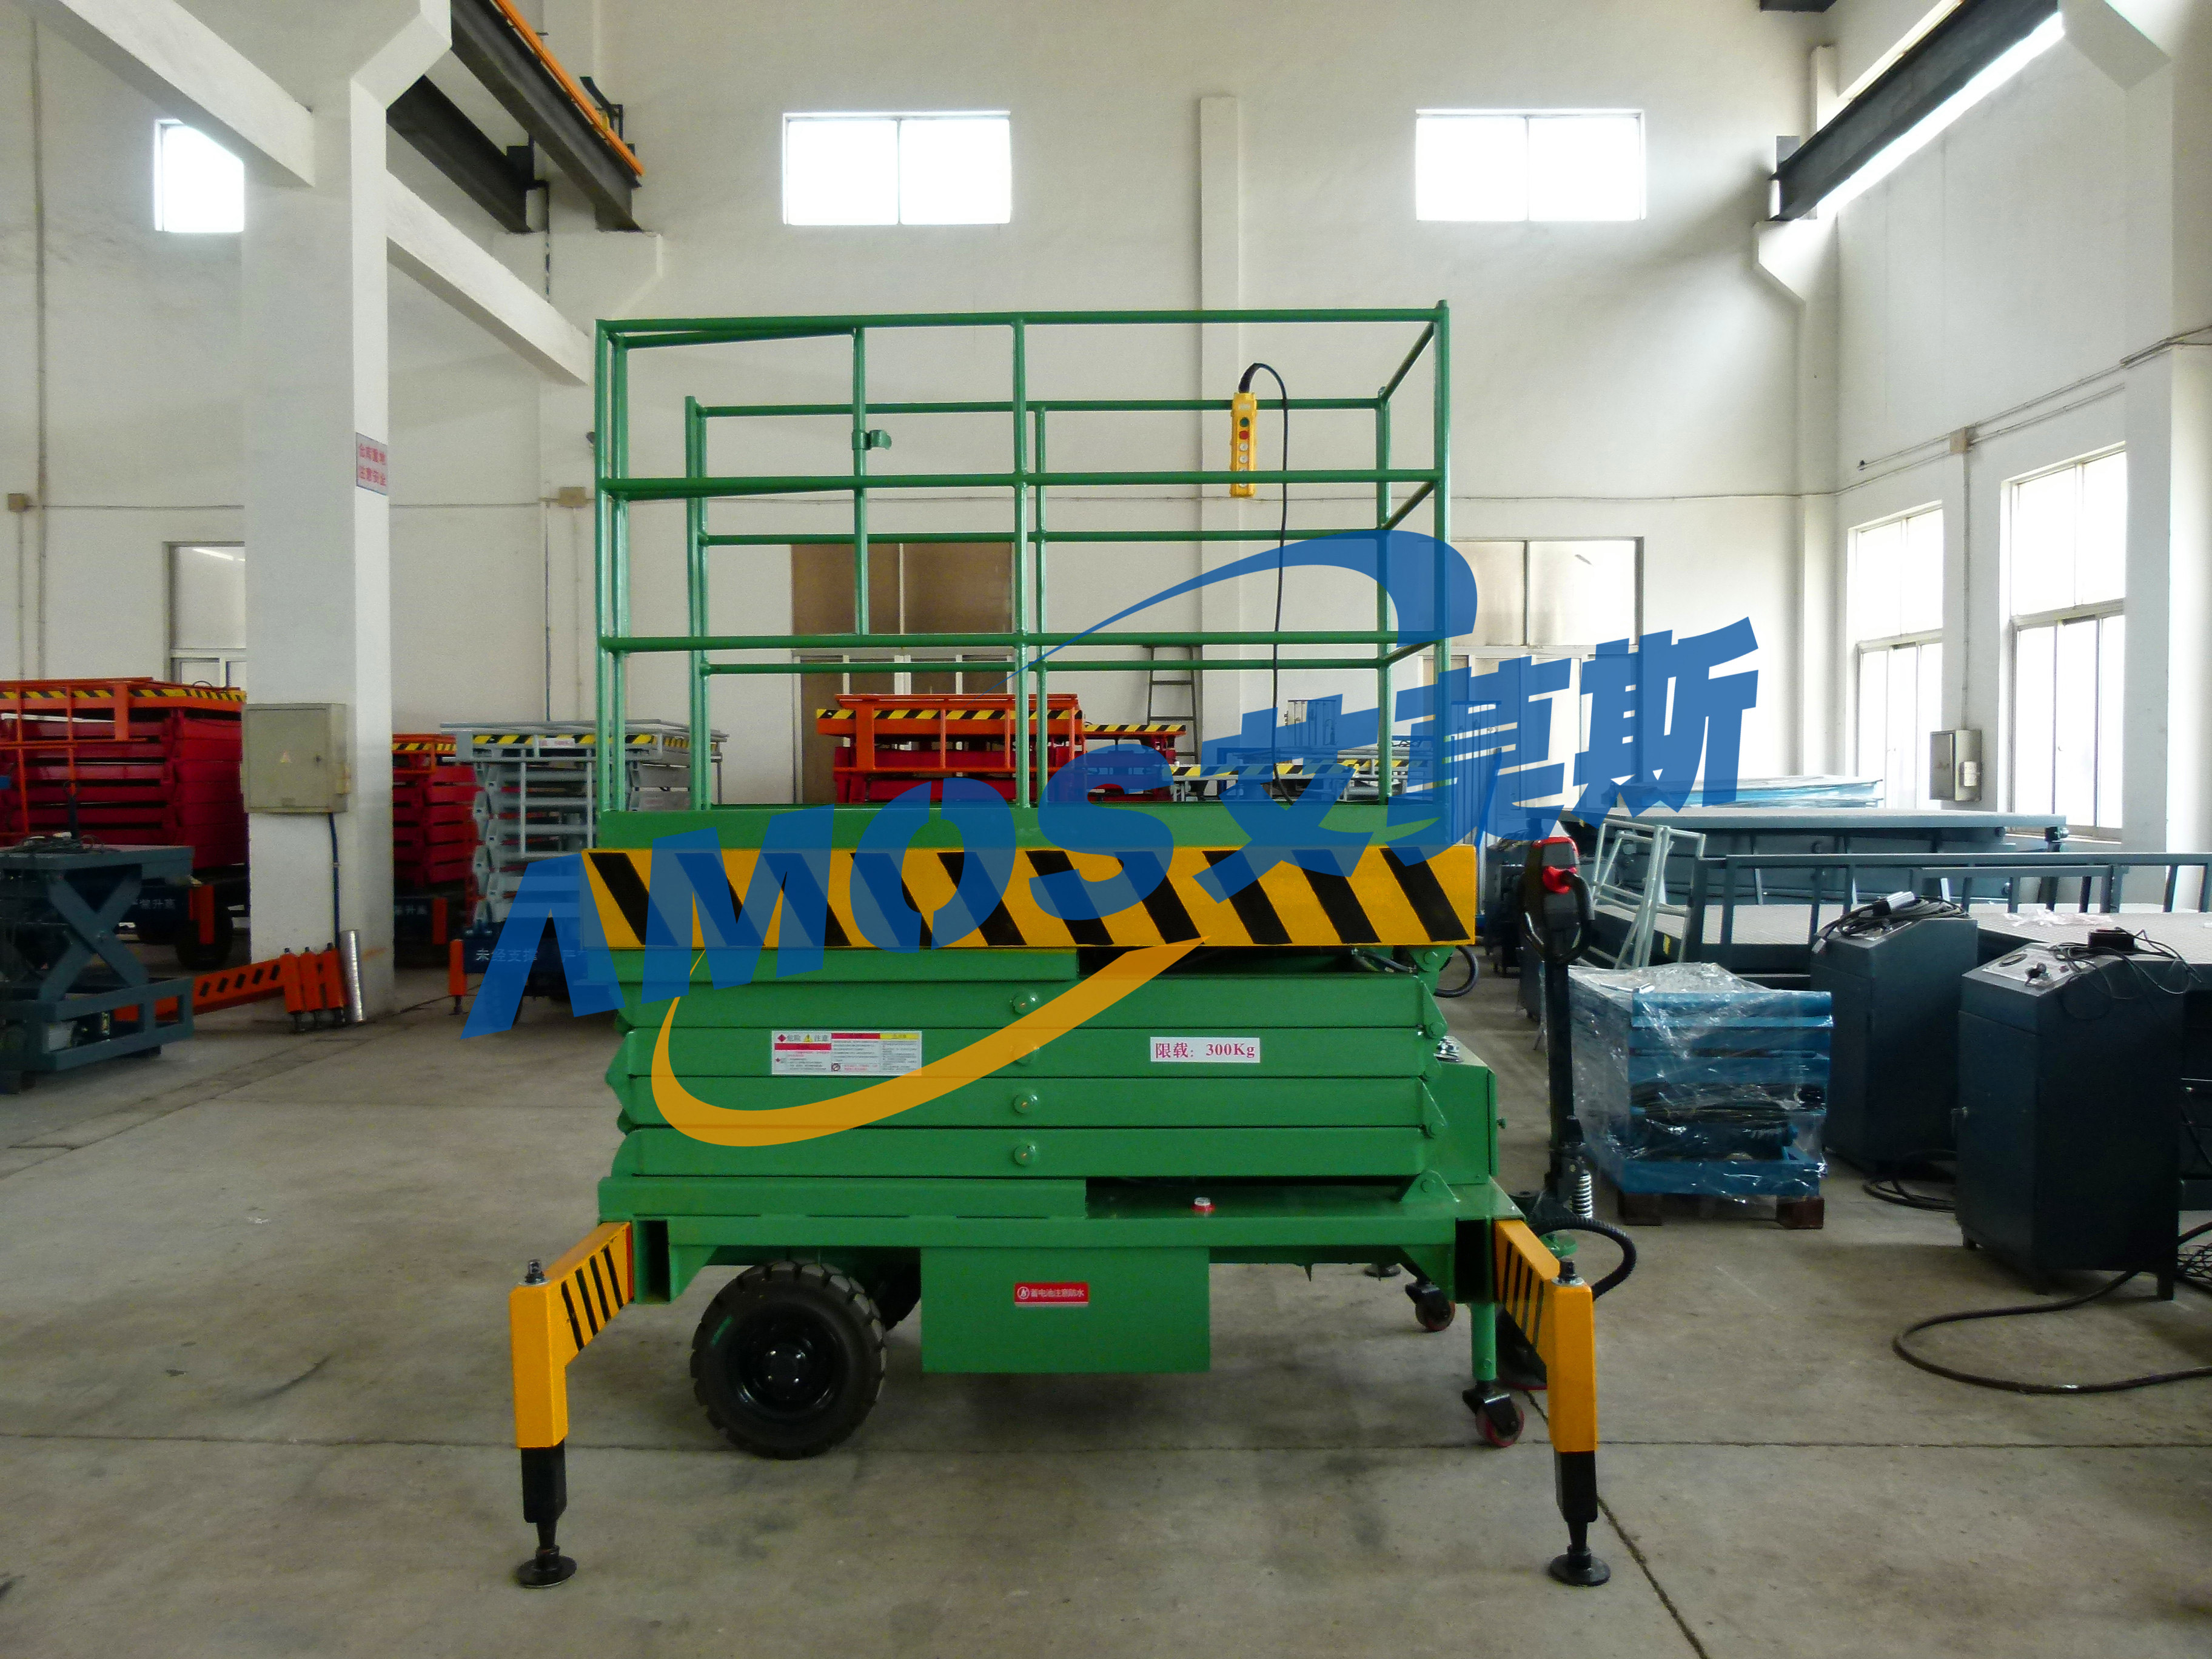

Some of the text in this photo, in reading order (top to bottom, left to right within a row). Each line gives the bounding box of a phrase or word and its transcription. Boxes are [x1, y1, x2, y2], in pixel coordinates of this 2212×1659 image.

[359, 464, 386, 487] 注意安全
[1206, 1043, 1255, 1058] 300Kg
